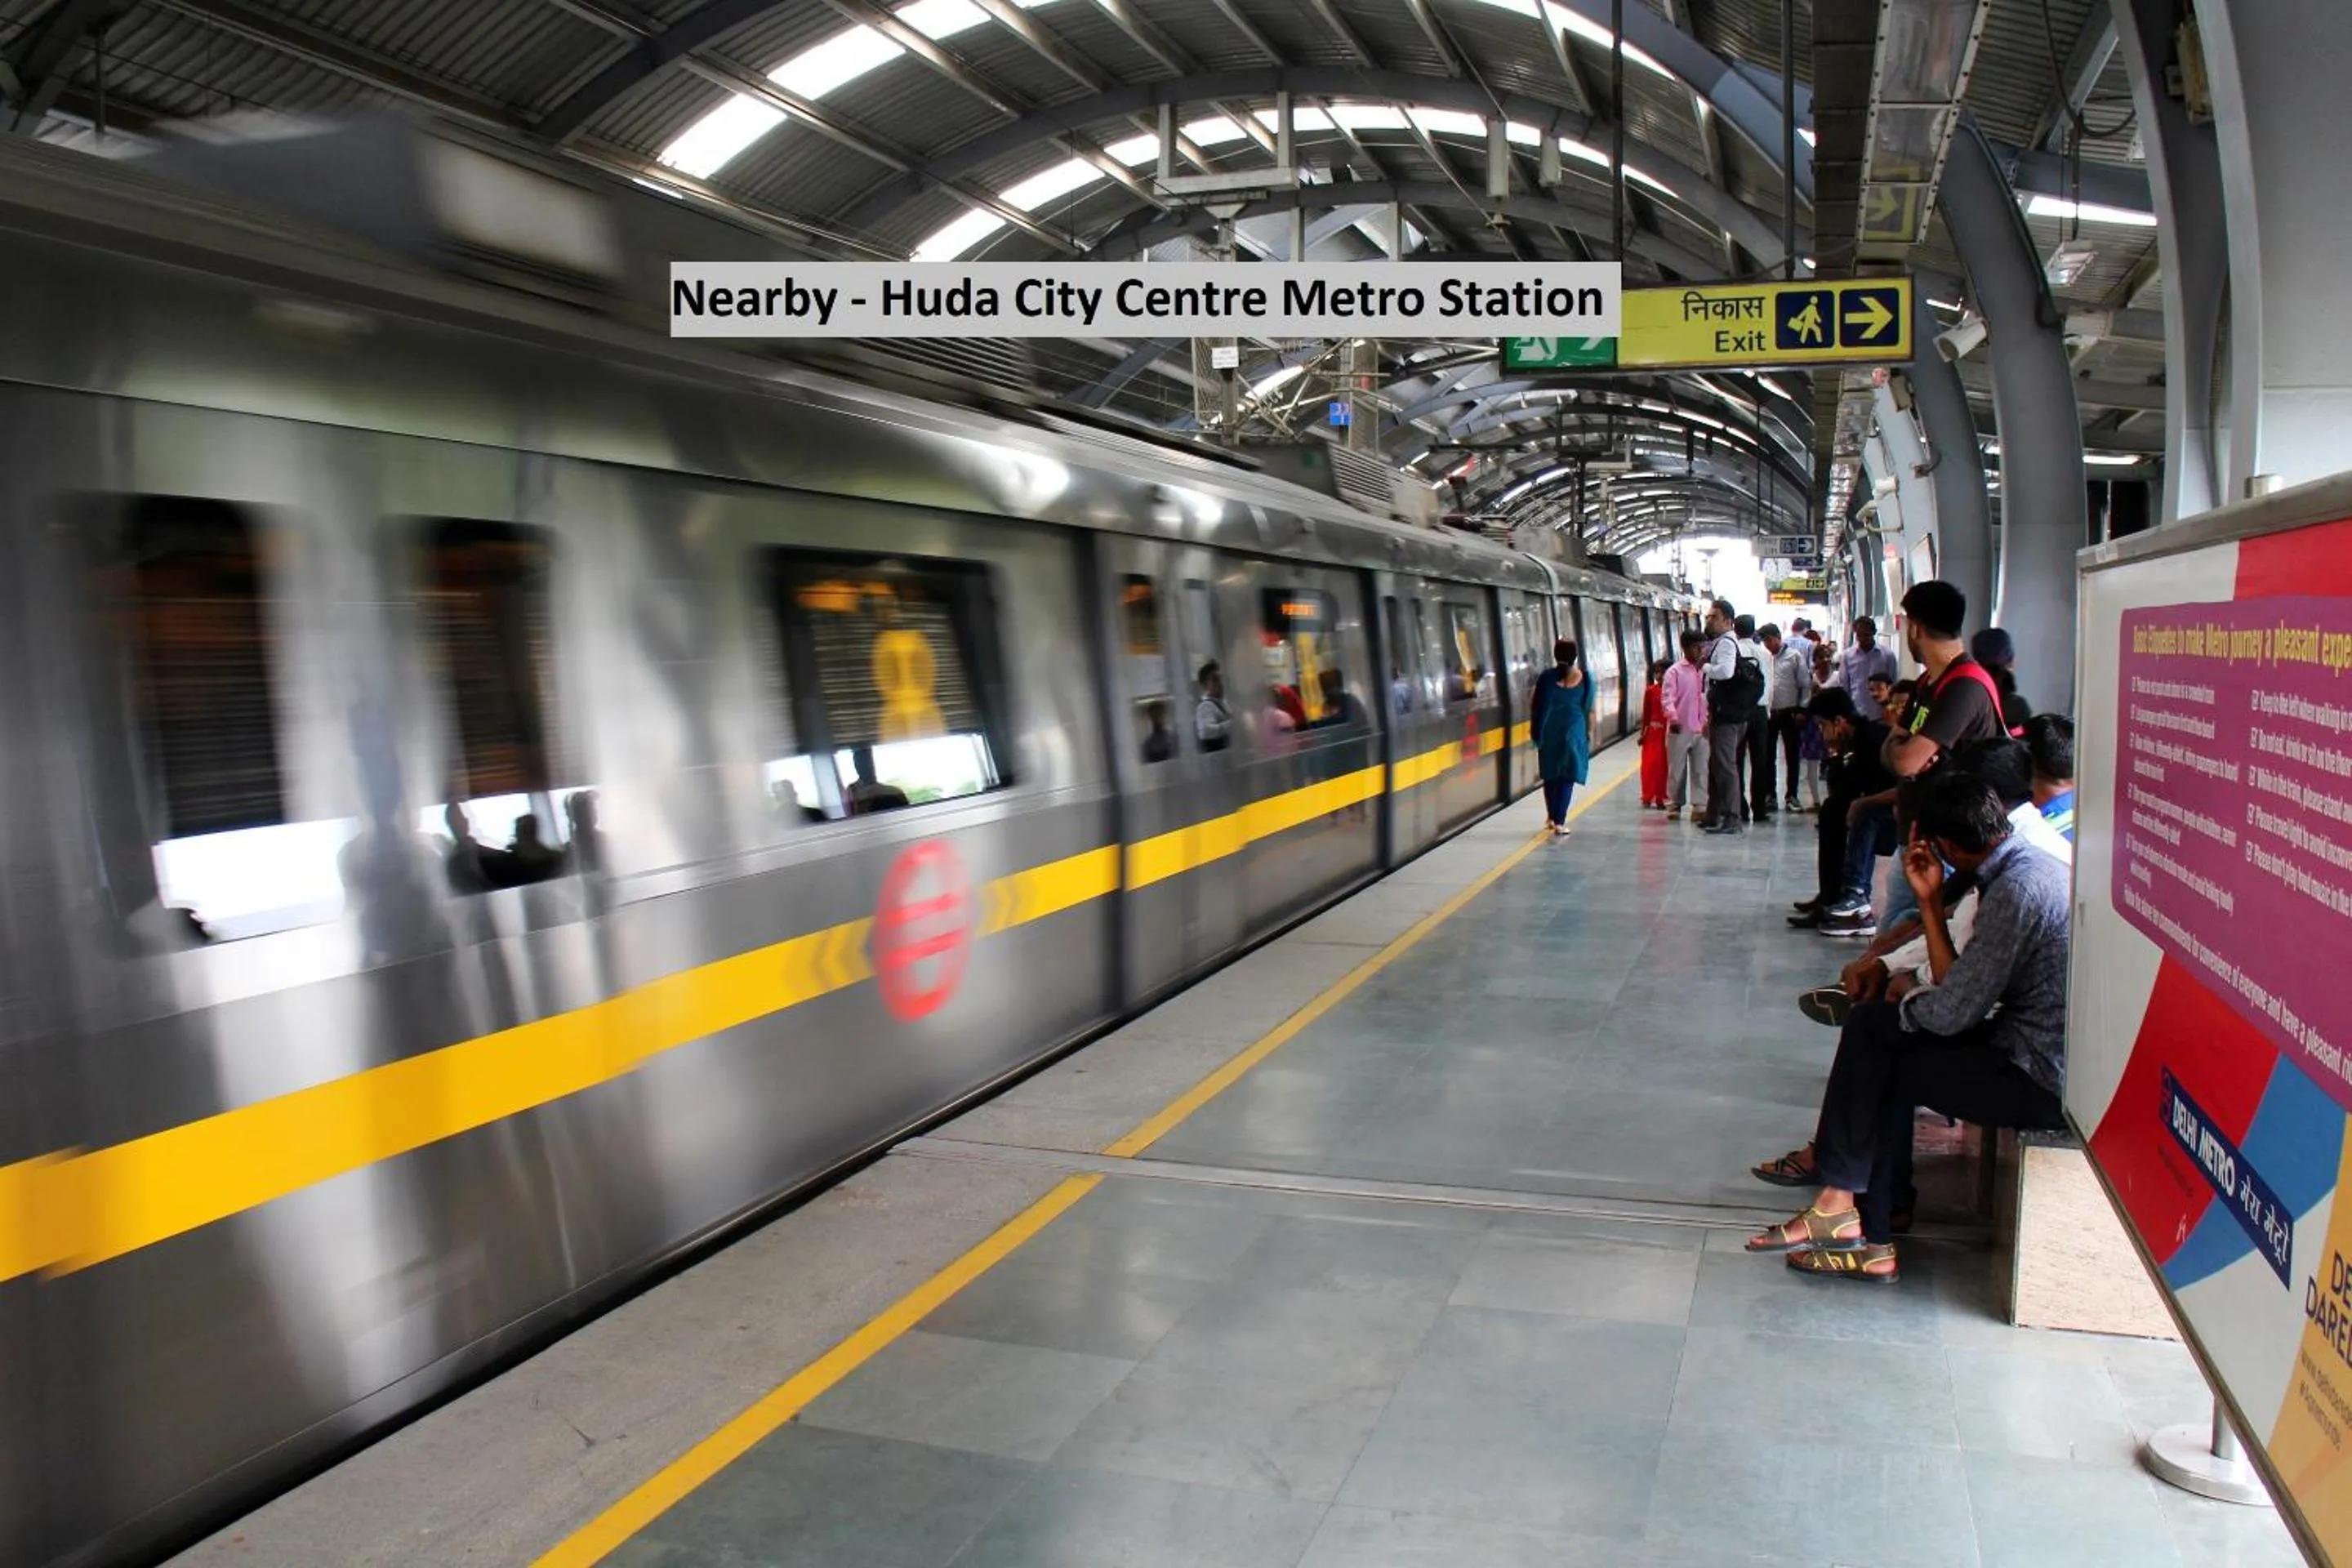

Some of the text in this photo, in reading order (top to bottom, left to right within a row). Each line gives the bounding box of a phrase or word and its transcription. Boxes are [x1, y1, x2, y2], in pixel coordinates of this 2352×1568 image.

[1681, 291, 1766, 321] निकास
[1716, 330, 1766, 352] Exit
[2205, 622, 2228, 658] Metro
[2229, 622, 2263, 667] journey
[2265, 629, 2271, 659] a
[2273, 619, 2319, 667] pleasant
[2281, 1000, 2299, 1039] have
[2299, 1022, 2305, 1045] a
[2305, 1026, 2341, 1076] pleasant
[2172, 1094, 2198, 1153] DELHI
[2198, 1125, 2235, 1197] METRO
